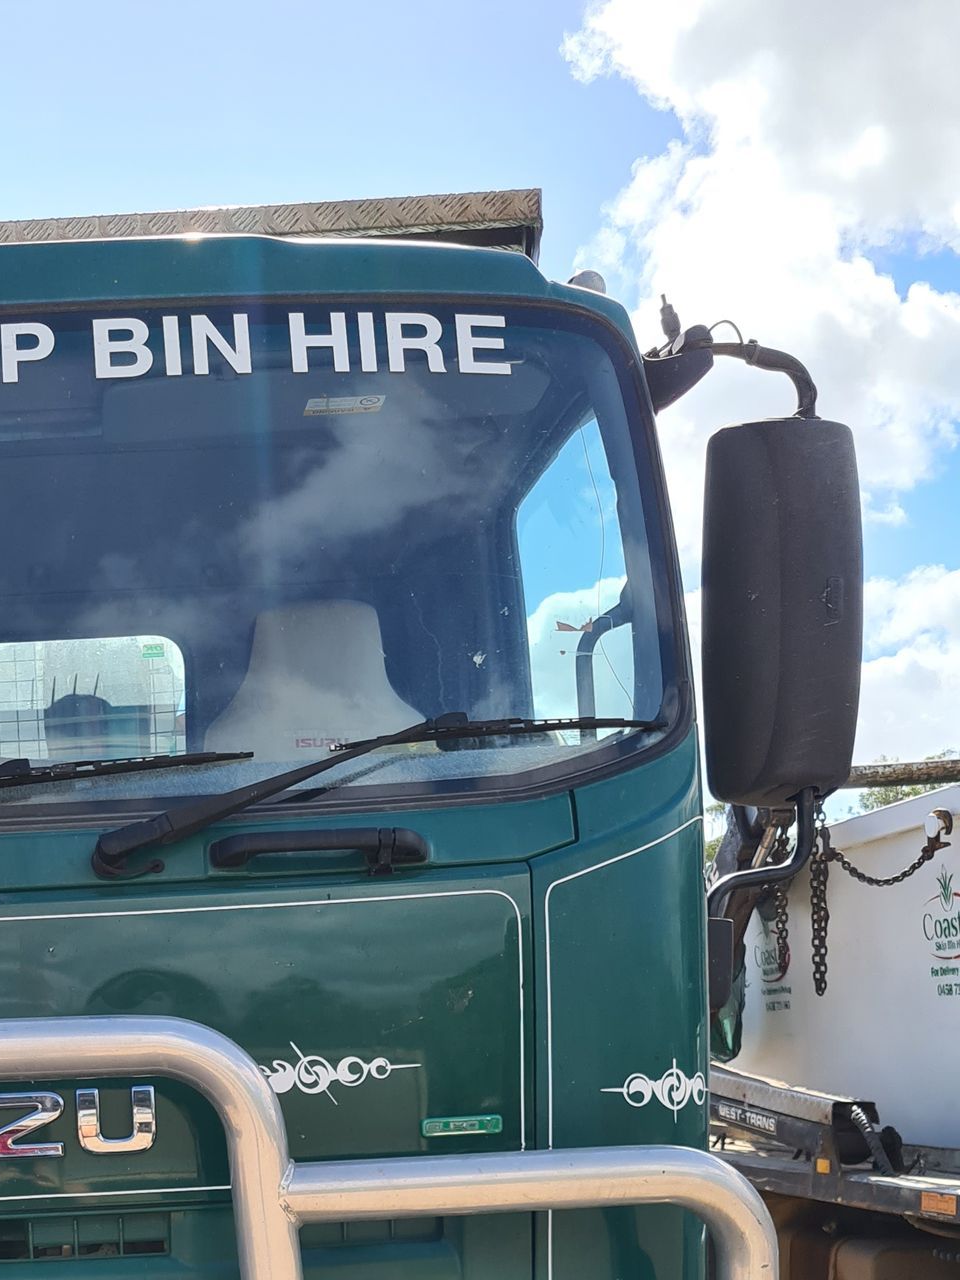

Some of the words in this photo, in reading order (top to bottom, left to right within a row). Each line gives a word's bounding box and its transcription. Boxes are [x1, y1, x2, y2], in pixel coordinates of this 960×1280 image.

[92, 313, 252, 379] BIN
[288, 312, 512, 375] HIRE
[719, 1103, 776, 1132] WEST-TRANS
